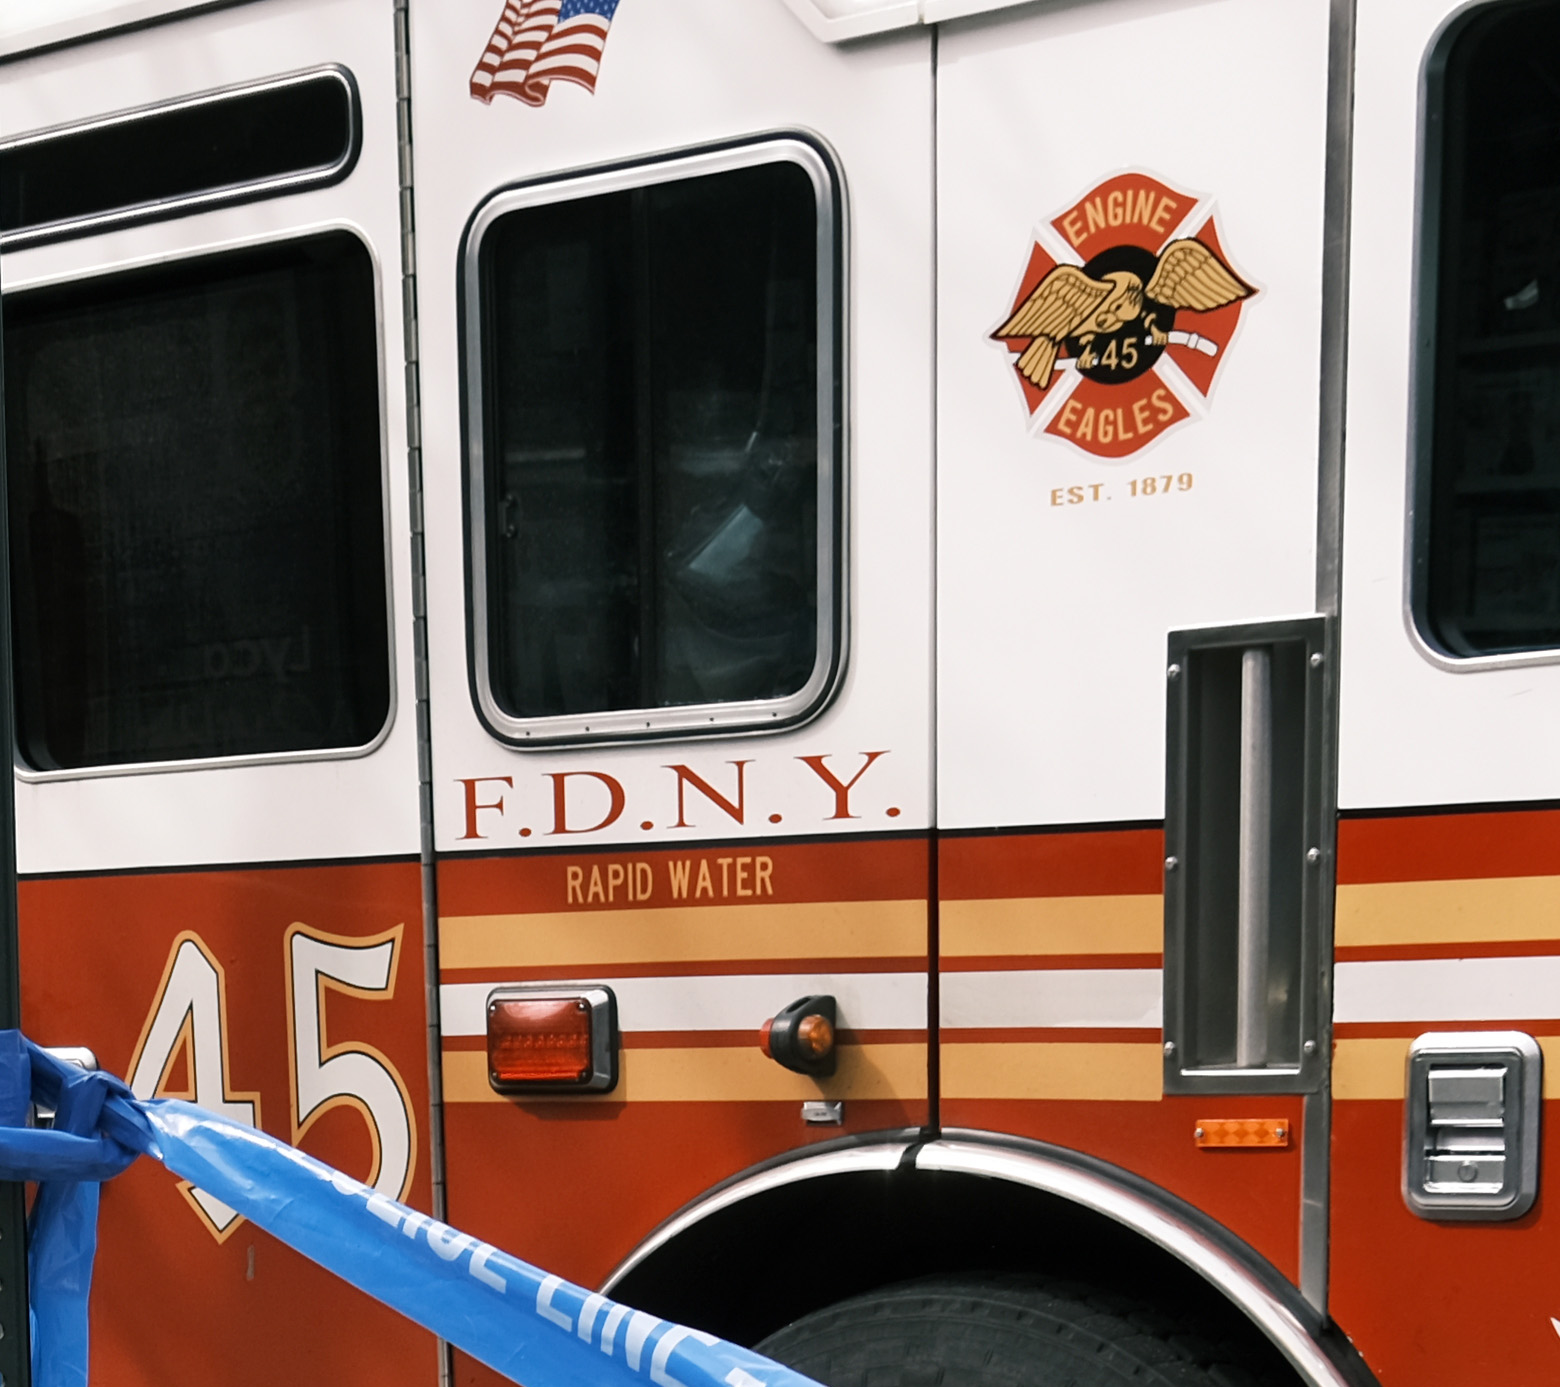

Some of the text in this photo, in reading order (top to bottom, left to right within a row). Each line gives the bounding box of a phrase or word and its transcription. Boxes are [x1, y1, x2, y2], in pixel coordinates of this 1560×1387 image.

[1061, 190, 1179, 247] ENGINE
[1100, 336, 1140, 372] 45
[1056, 388, 1177, 447] EAGLES
[1049, 472, 1195, 509] EST. 1879
[454, 751, 902, 841] F.D.N.Y.
[566, 856, 775, 905] RAPID WATER
[124, 922, 417, 1243] 45
